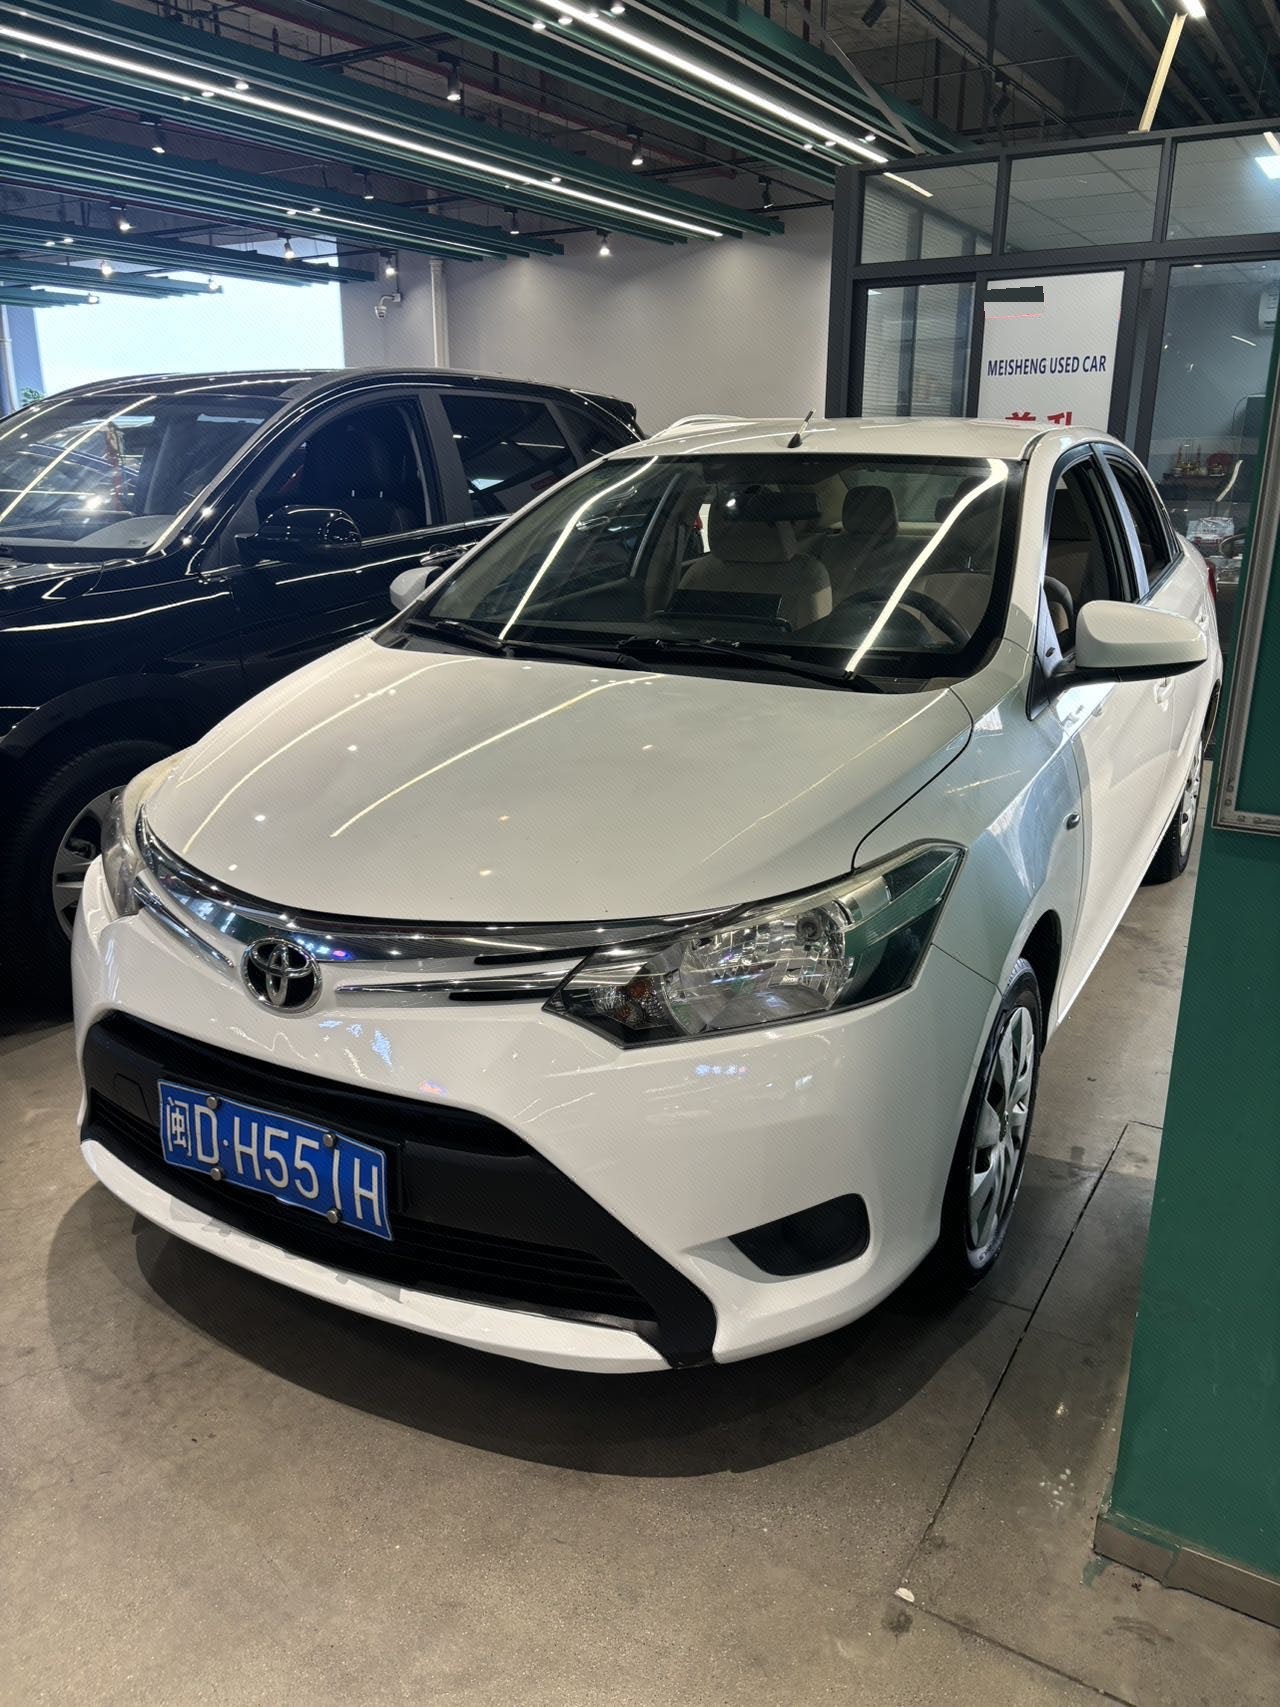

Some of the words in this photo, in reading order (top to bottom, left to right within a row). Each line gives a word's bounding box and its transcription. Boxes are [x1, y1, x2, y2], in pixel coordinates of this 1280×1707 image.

[987, 358, 1047, 377] MEISHENG
[1049, 356, 1080, 374] USED
[1082, 355, 1107, 373] CAR
